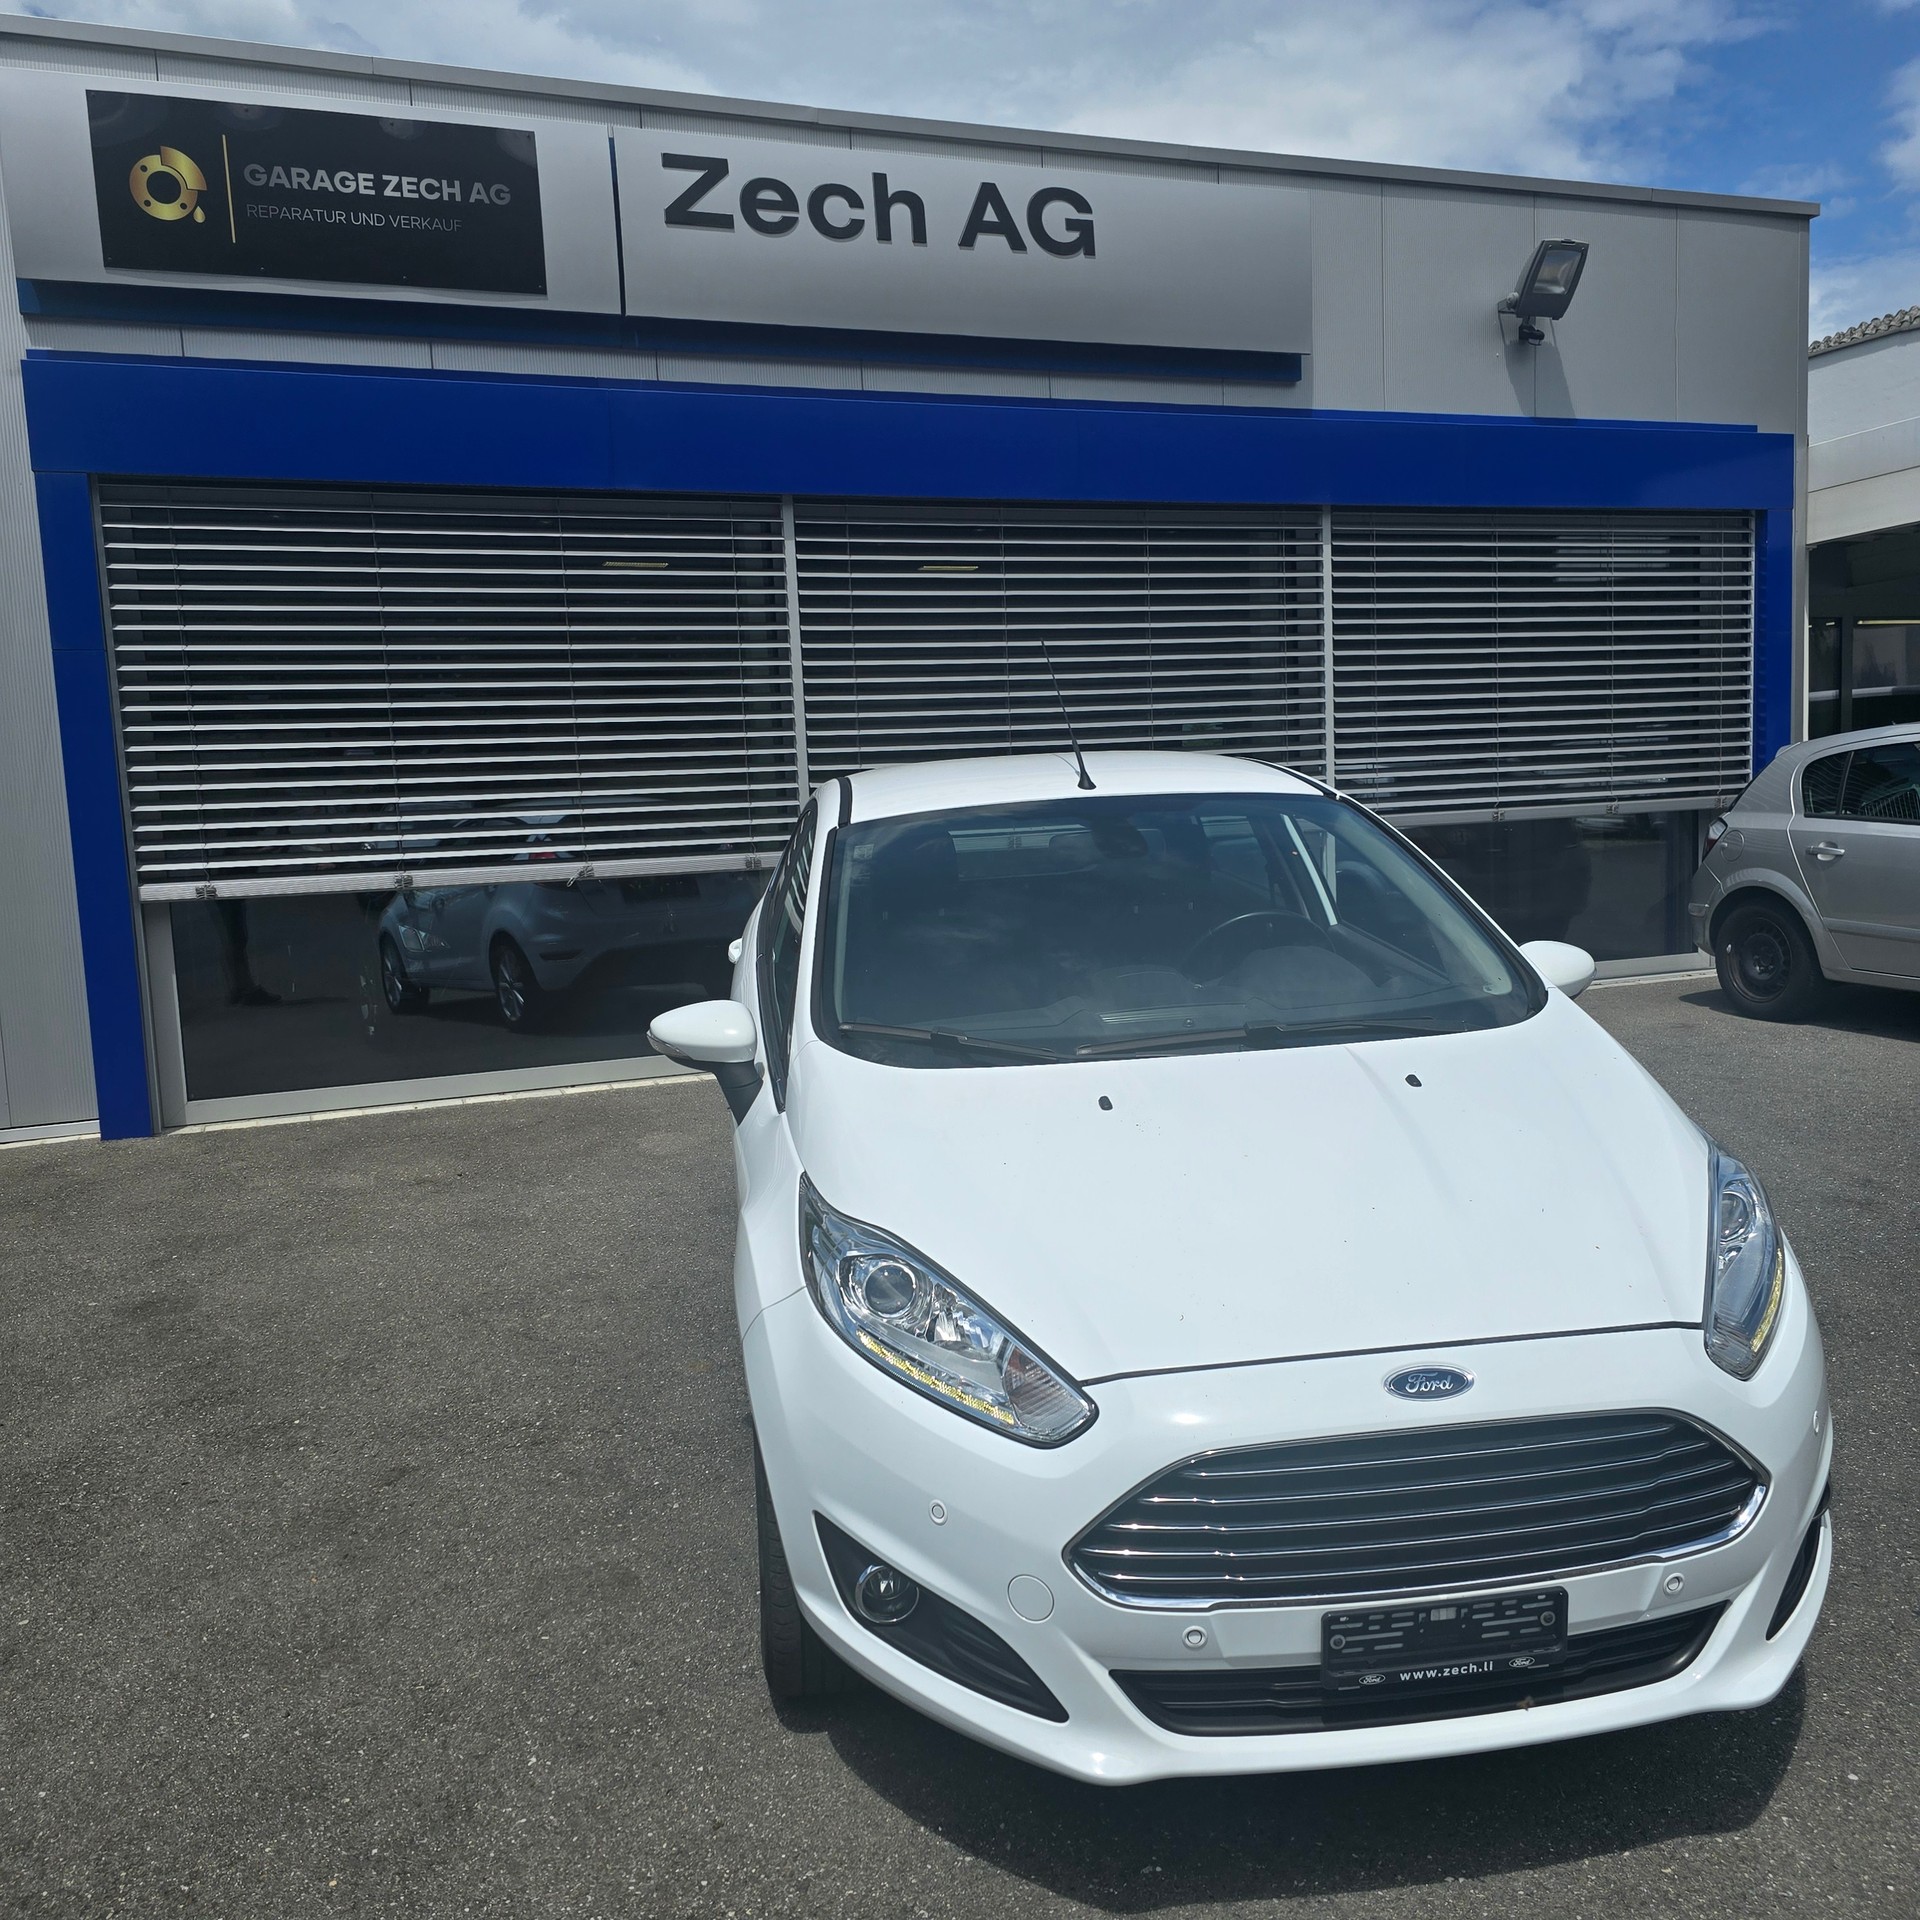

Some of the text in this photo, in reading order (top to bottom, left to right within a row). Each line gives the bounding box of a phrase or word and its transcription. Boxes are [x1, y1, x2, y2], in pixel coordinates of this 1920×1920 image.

[243, 163, 511, 205] GARAGE ZECH AG
[246, 203, 463, 232] REPARATUR UND VERKAUF
[661, 152, 1096, 258] Zech AG
[1400, 1661, 1493, 1681] www.zech.li
